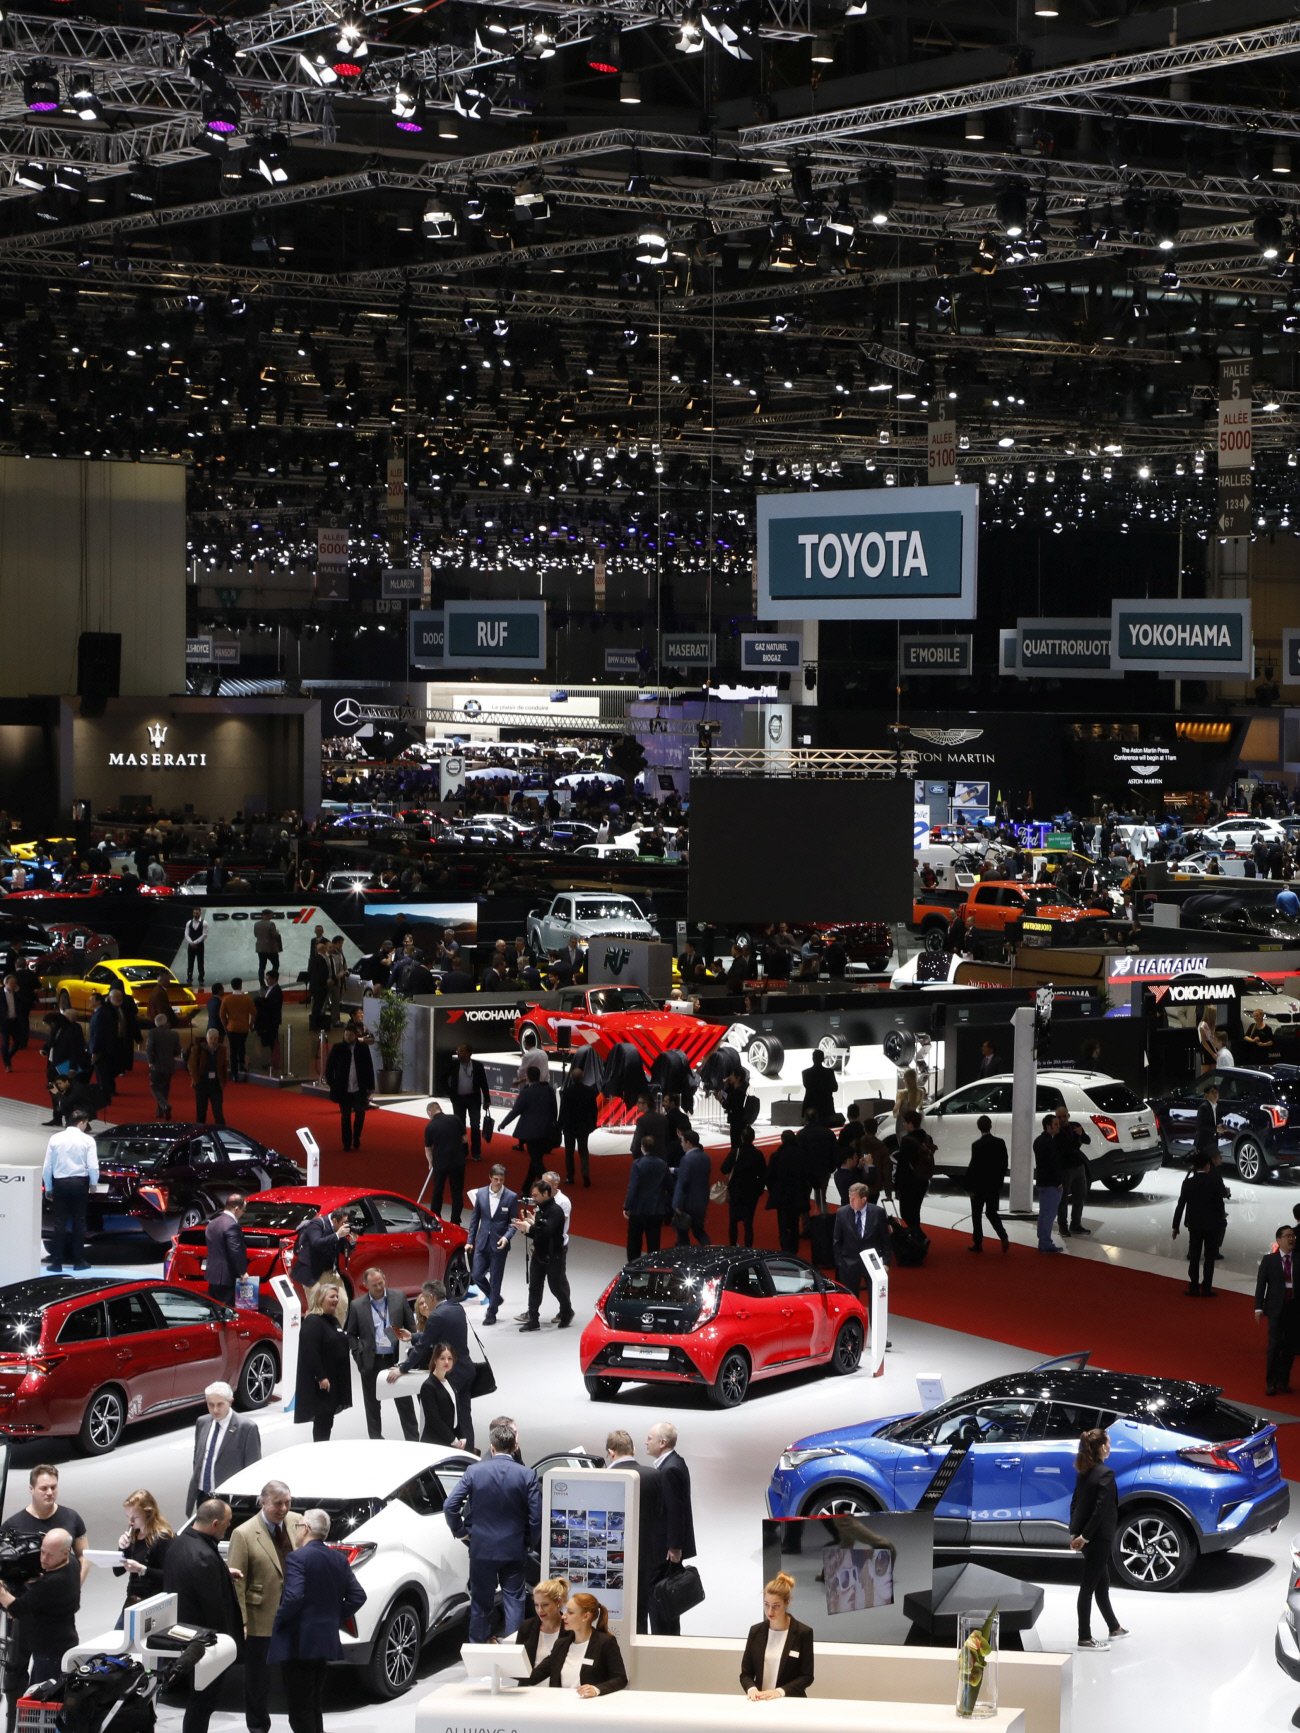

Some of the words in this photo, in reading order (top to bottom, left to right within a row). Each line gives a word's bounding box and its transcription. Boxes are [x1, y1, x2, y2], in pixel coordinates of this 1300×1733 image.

[1223, 365, 1249, 378] HALLE
[1232, 380, 1239, 400] 5
[939, 403, 945, 421] 5
[1224, 411, 1247, 425] ALLÉE
[932, 433, 952, 444] ALLÉE
[1220, 430, 1251, 450] 5000
[929, 449, 955, 467] 5100
[1219, 474, 1251, 487] HALLES
[388, 482, 403, 496] 5200
[1226, 499, 1243, 509] 1234
[1225, 517, 1233, 526] 67
[322, 533, 345, 541] ALLÉE
[320, 543, 348, 554] 6000
[798, 530, 928, 579] TOYOTA
[321, 566, 346, 574] HALLE
[390, 579, 414, 588] McLAREN
[423, 633, 443, 644] DODG
[477, 621, 508, 646] RUF
[1129, 624, 1231, 647] YOKOHAMA
[186, 644, 209, 653] LS-ROYCE
[215, 648, 236, 657] MANSORY
[669, 643, 709, 656] MASERATI
[755, 643, 765, 651] GAZ
[766, 643, 788, 651] NATUREL
[763, 654, 781, 662] BIOGAZ
[109, 753, 206, 766] MASERATI
[948, 752, 995, 763] MARTIN
[1147, 754, 1159, 763] begin
[1018, 827, 1039, 848] Ford
[1133, 957, 1210, 975] HAMANN
[1169, 984, 1236, 1001] YOKOHAMA
[465, 1009, 522, 1021] YOKOHAMA
